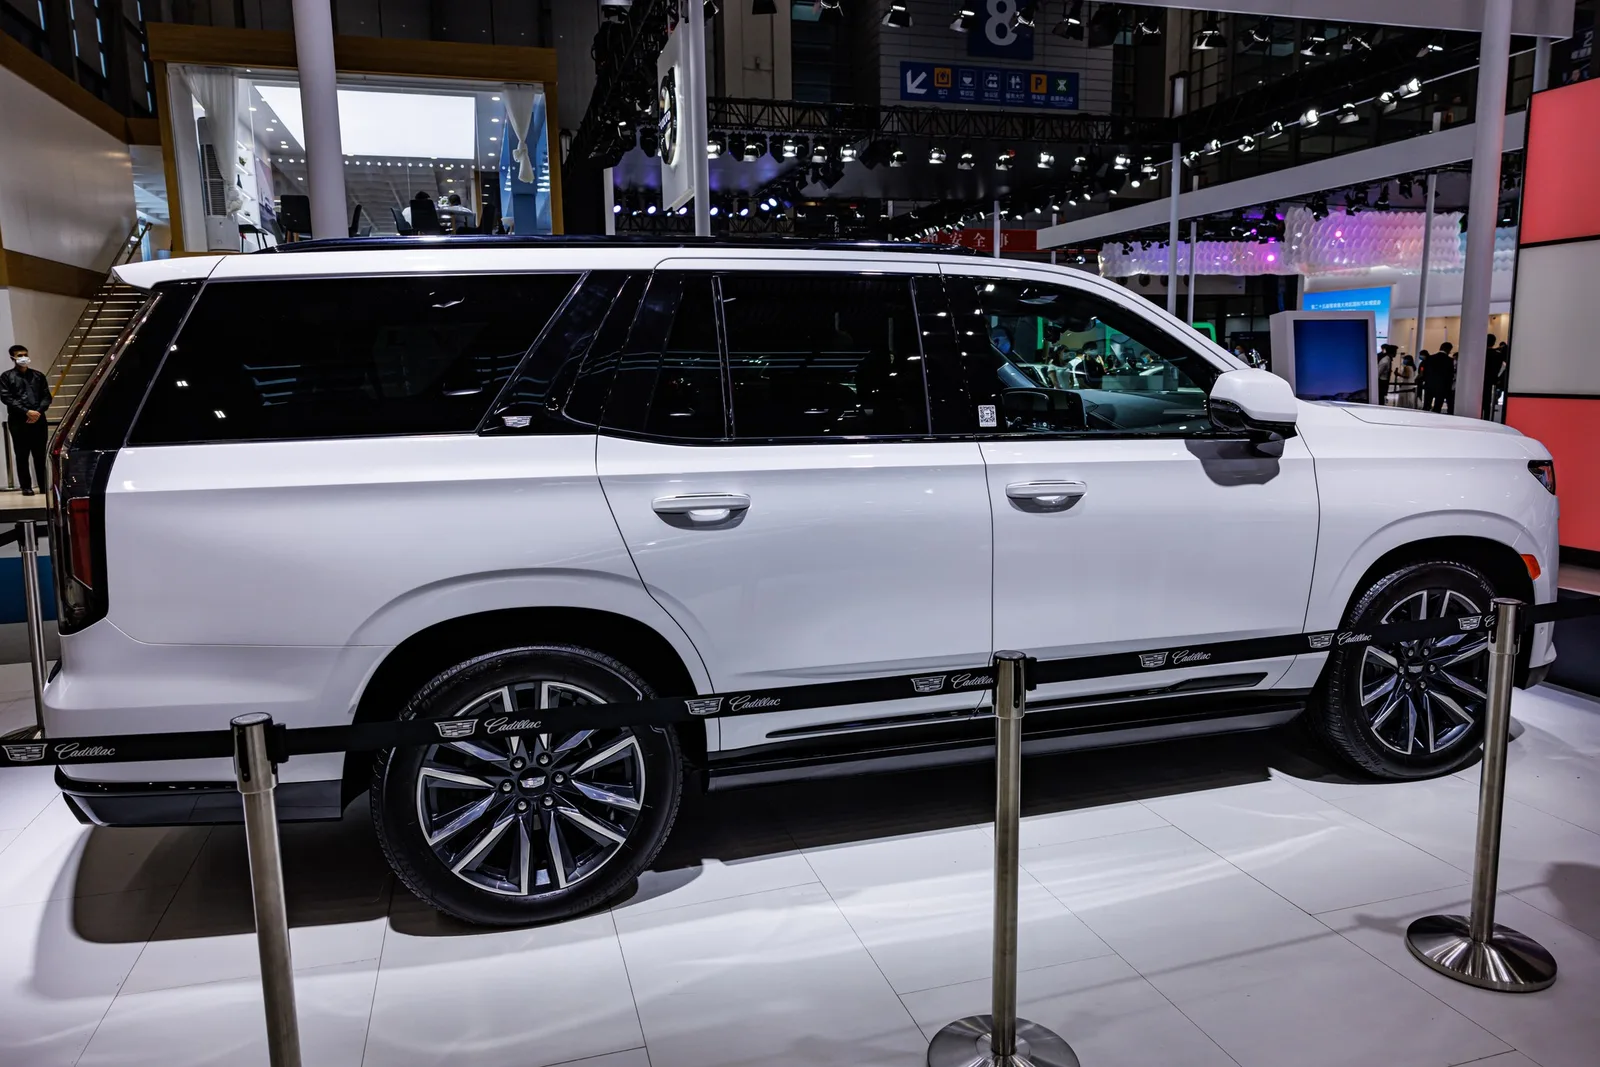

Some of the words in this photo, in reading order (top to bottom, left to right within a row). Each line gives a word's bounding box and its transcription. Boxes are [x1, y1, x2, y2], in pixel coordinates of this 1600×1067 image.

[985, 0, 1018, 46] 8
[1337, 631, 1372, 645] Cadillac
[1172, 649, 1211, 664] Cadillac
[728, 695, 781, 712] Cadillac
[484, 716, 542, 734] Cadillac
[54, 742, 116, 760] Cadillac
